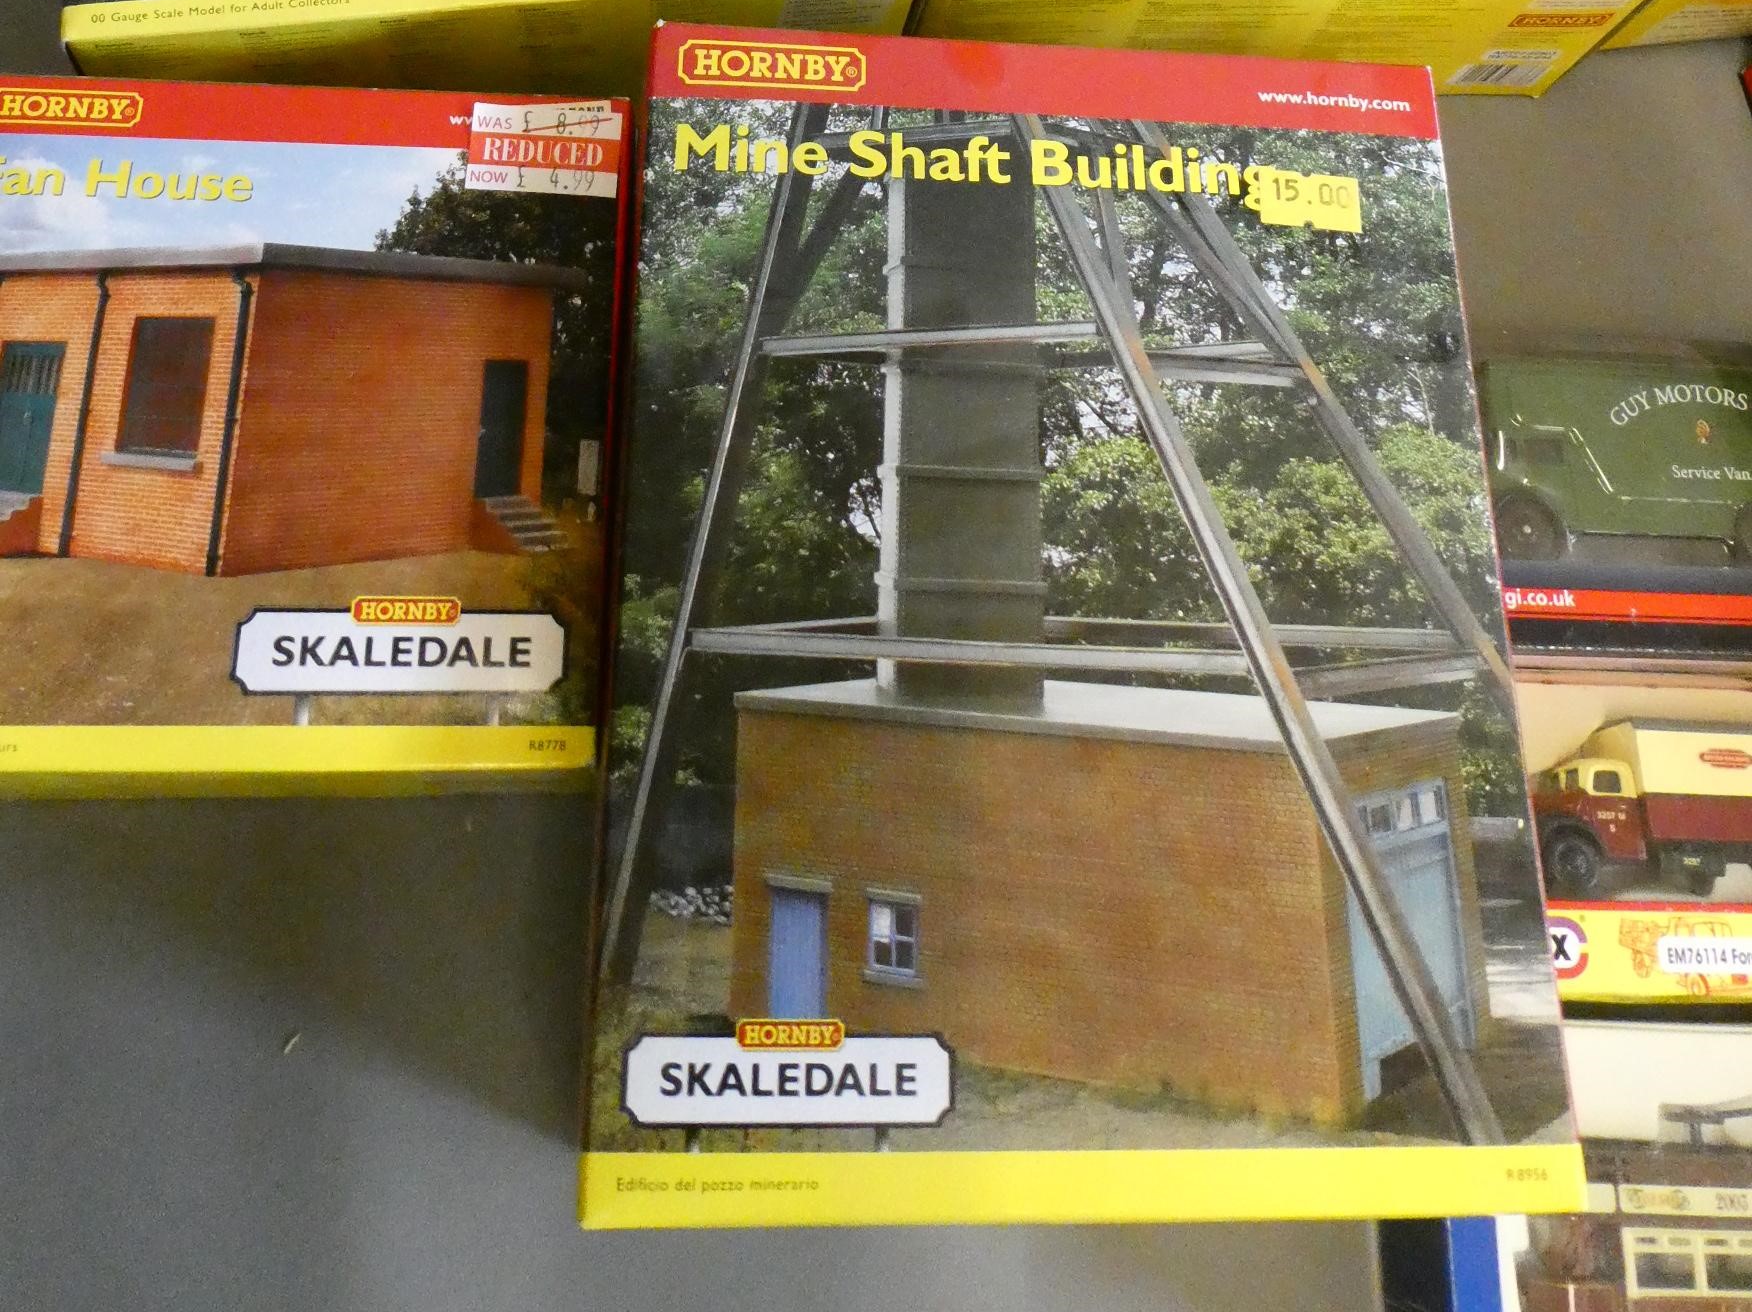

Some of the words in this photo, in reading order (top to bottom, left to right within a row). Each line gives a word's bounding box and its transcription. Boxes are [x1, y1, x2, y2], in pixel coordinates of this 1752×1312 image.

[111, 10, 149, 24] Gauge
[153, 8, 184, 20] Scale
[189, 6, 226, 17] Model
[230, 3, 249, 14] for
[251, 1, 284, 11] Adult
[693, 48, 850, 83] HORNBY
[0, 94, 132, 120] HORNBY
[1257, 89, 1412, 113] www.hornby.com
[477, 114, 514, 130] WAS
[482, 137, 604, 167] REDUCED
[0, 156, 66, 197] an
[84, 158, 255, 203] House
[469, 170, 509, 184] NOW
[674, 123, 830, 175] Mine
[847, 130, 1012, 185] Shaft
[1030, 138, 1275, 211] Building
[1271, 176, 1350, 209] 15.00
[1609, 390, 1651, 426] GUY
[1652, 383, 1749, 411] MOTORS
[1671, 464, 1721, 480] Service
[1723, 466, 1752, 481] Van
[360, 601, 452, 621] HORNBY
[272, 635, 533, 668] SKALEDALE
[1666, 946, 1728, 965] EM76114
[744, 1024, 835, 1046] HORNBY
[659, 1062, 918, 1097] SKALEDALE
[616, 1177, 669, 1191] Edificio
[674, 1177, 697, 1190] del
[701, 1179, 744, 1192] pozzo
